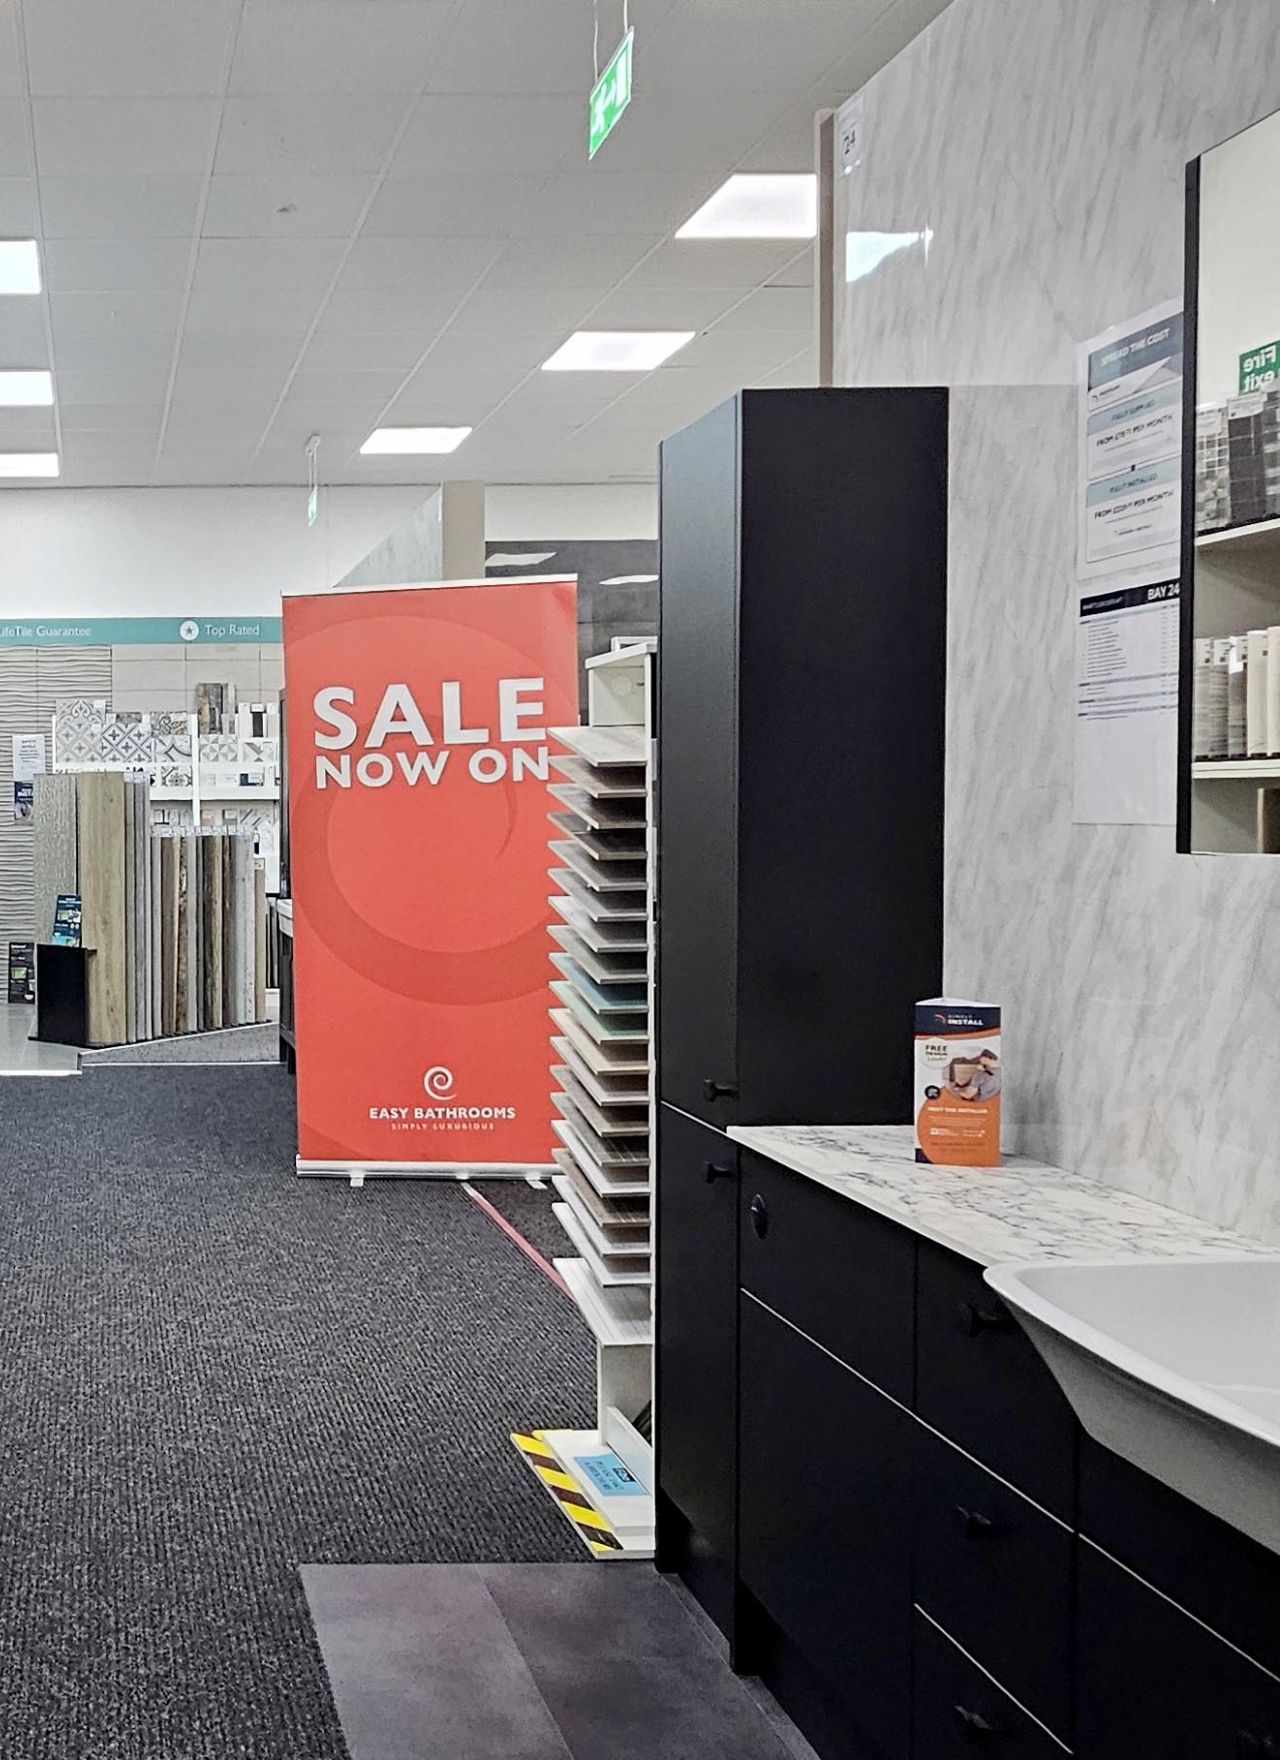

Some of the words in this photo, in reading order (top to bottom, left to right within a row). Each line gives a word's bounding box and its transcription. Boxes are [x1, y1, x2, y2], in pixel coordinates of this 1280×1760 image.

[1147, 586, 1168, 601] BAY
[1168, 582, 1180, 597] 24
[36, 625, 92, 638] Guarantee
[204, 625, 225, 638] Top
[229, 623, 261, 636] Rated
[313, 678, 547, 751] SALE
[315, 750, 450, 790] NOW
[469, 746, 549, 784] ON
[947, 1018, 984, 1026] INSTALL
[925, 1044, 948, 1052] FREE
[369, 1107, 409, 1120] EASY
[413, 1107, 516, 1120] BATHROOMS
[391, 1123, 428, 1131] SIMPLY
